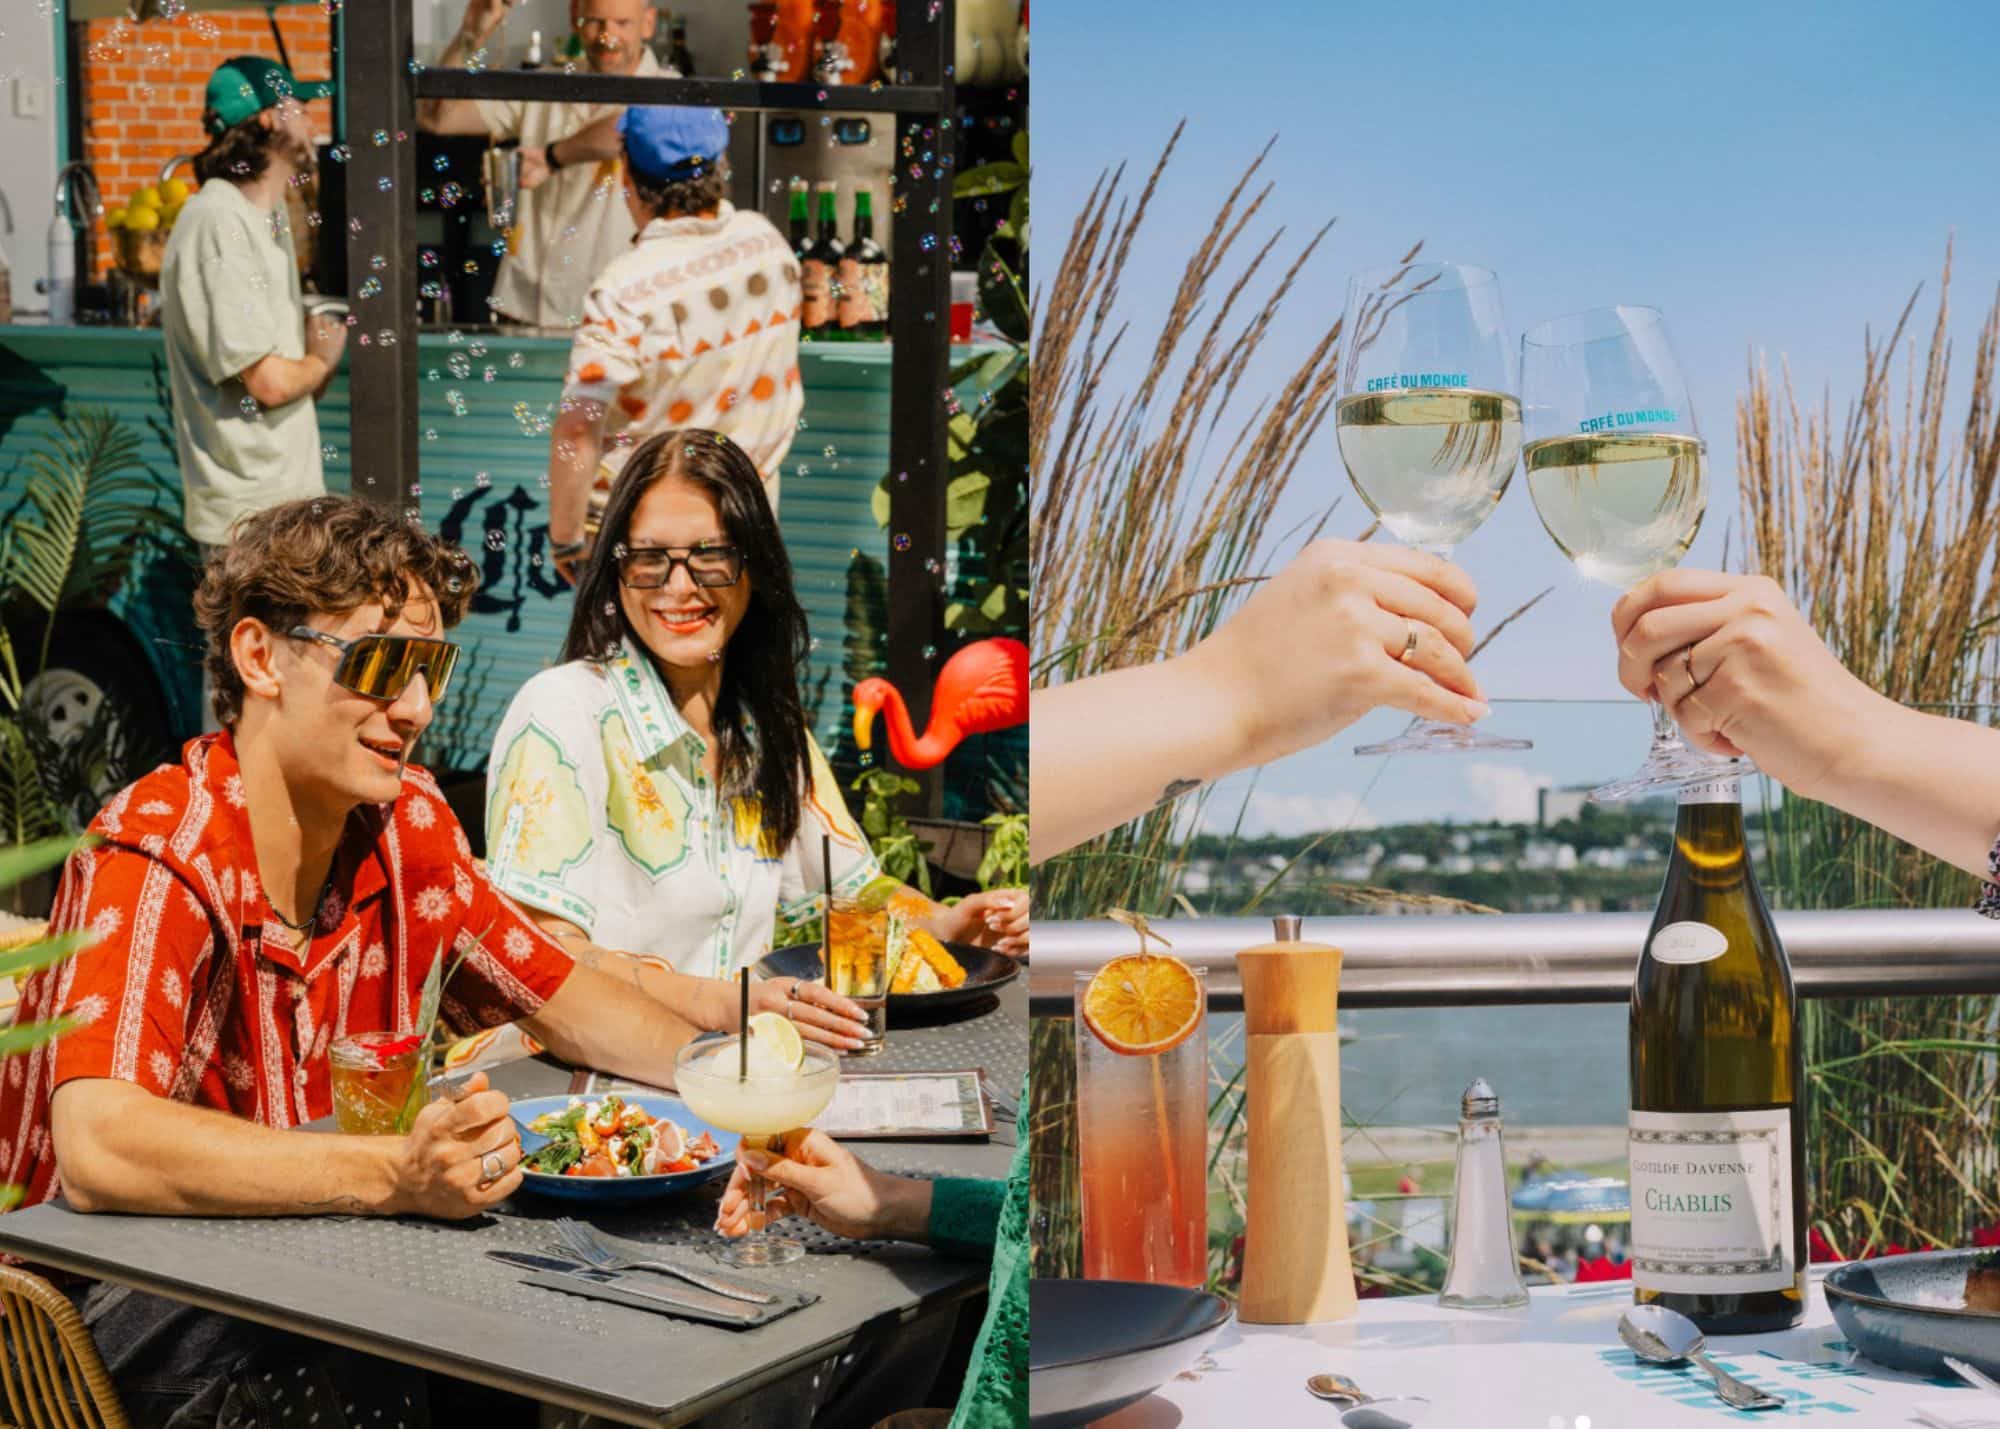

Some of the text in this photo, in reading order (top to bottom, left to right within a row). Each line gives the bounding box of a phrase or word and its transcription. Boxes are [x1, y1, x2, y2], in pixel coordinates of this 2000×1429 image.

[1367, 372, 1468, 392] CAFÉ DU MONDE
[1580, 409, 1680, 433] CAFÉ DU MONDE
[1687, 1162, 1755, 1175] DAVENNE
